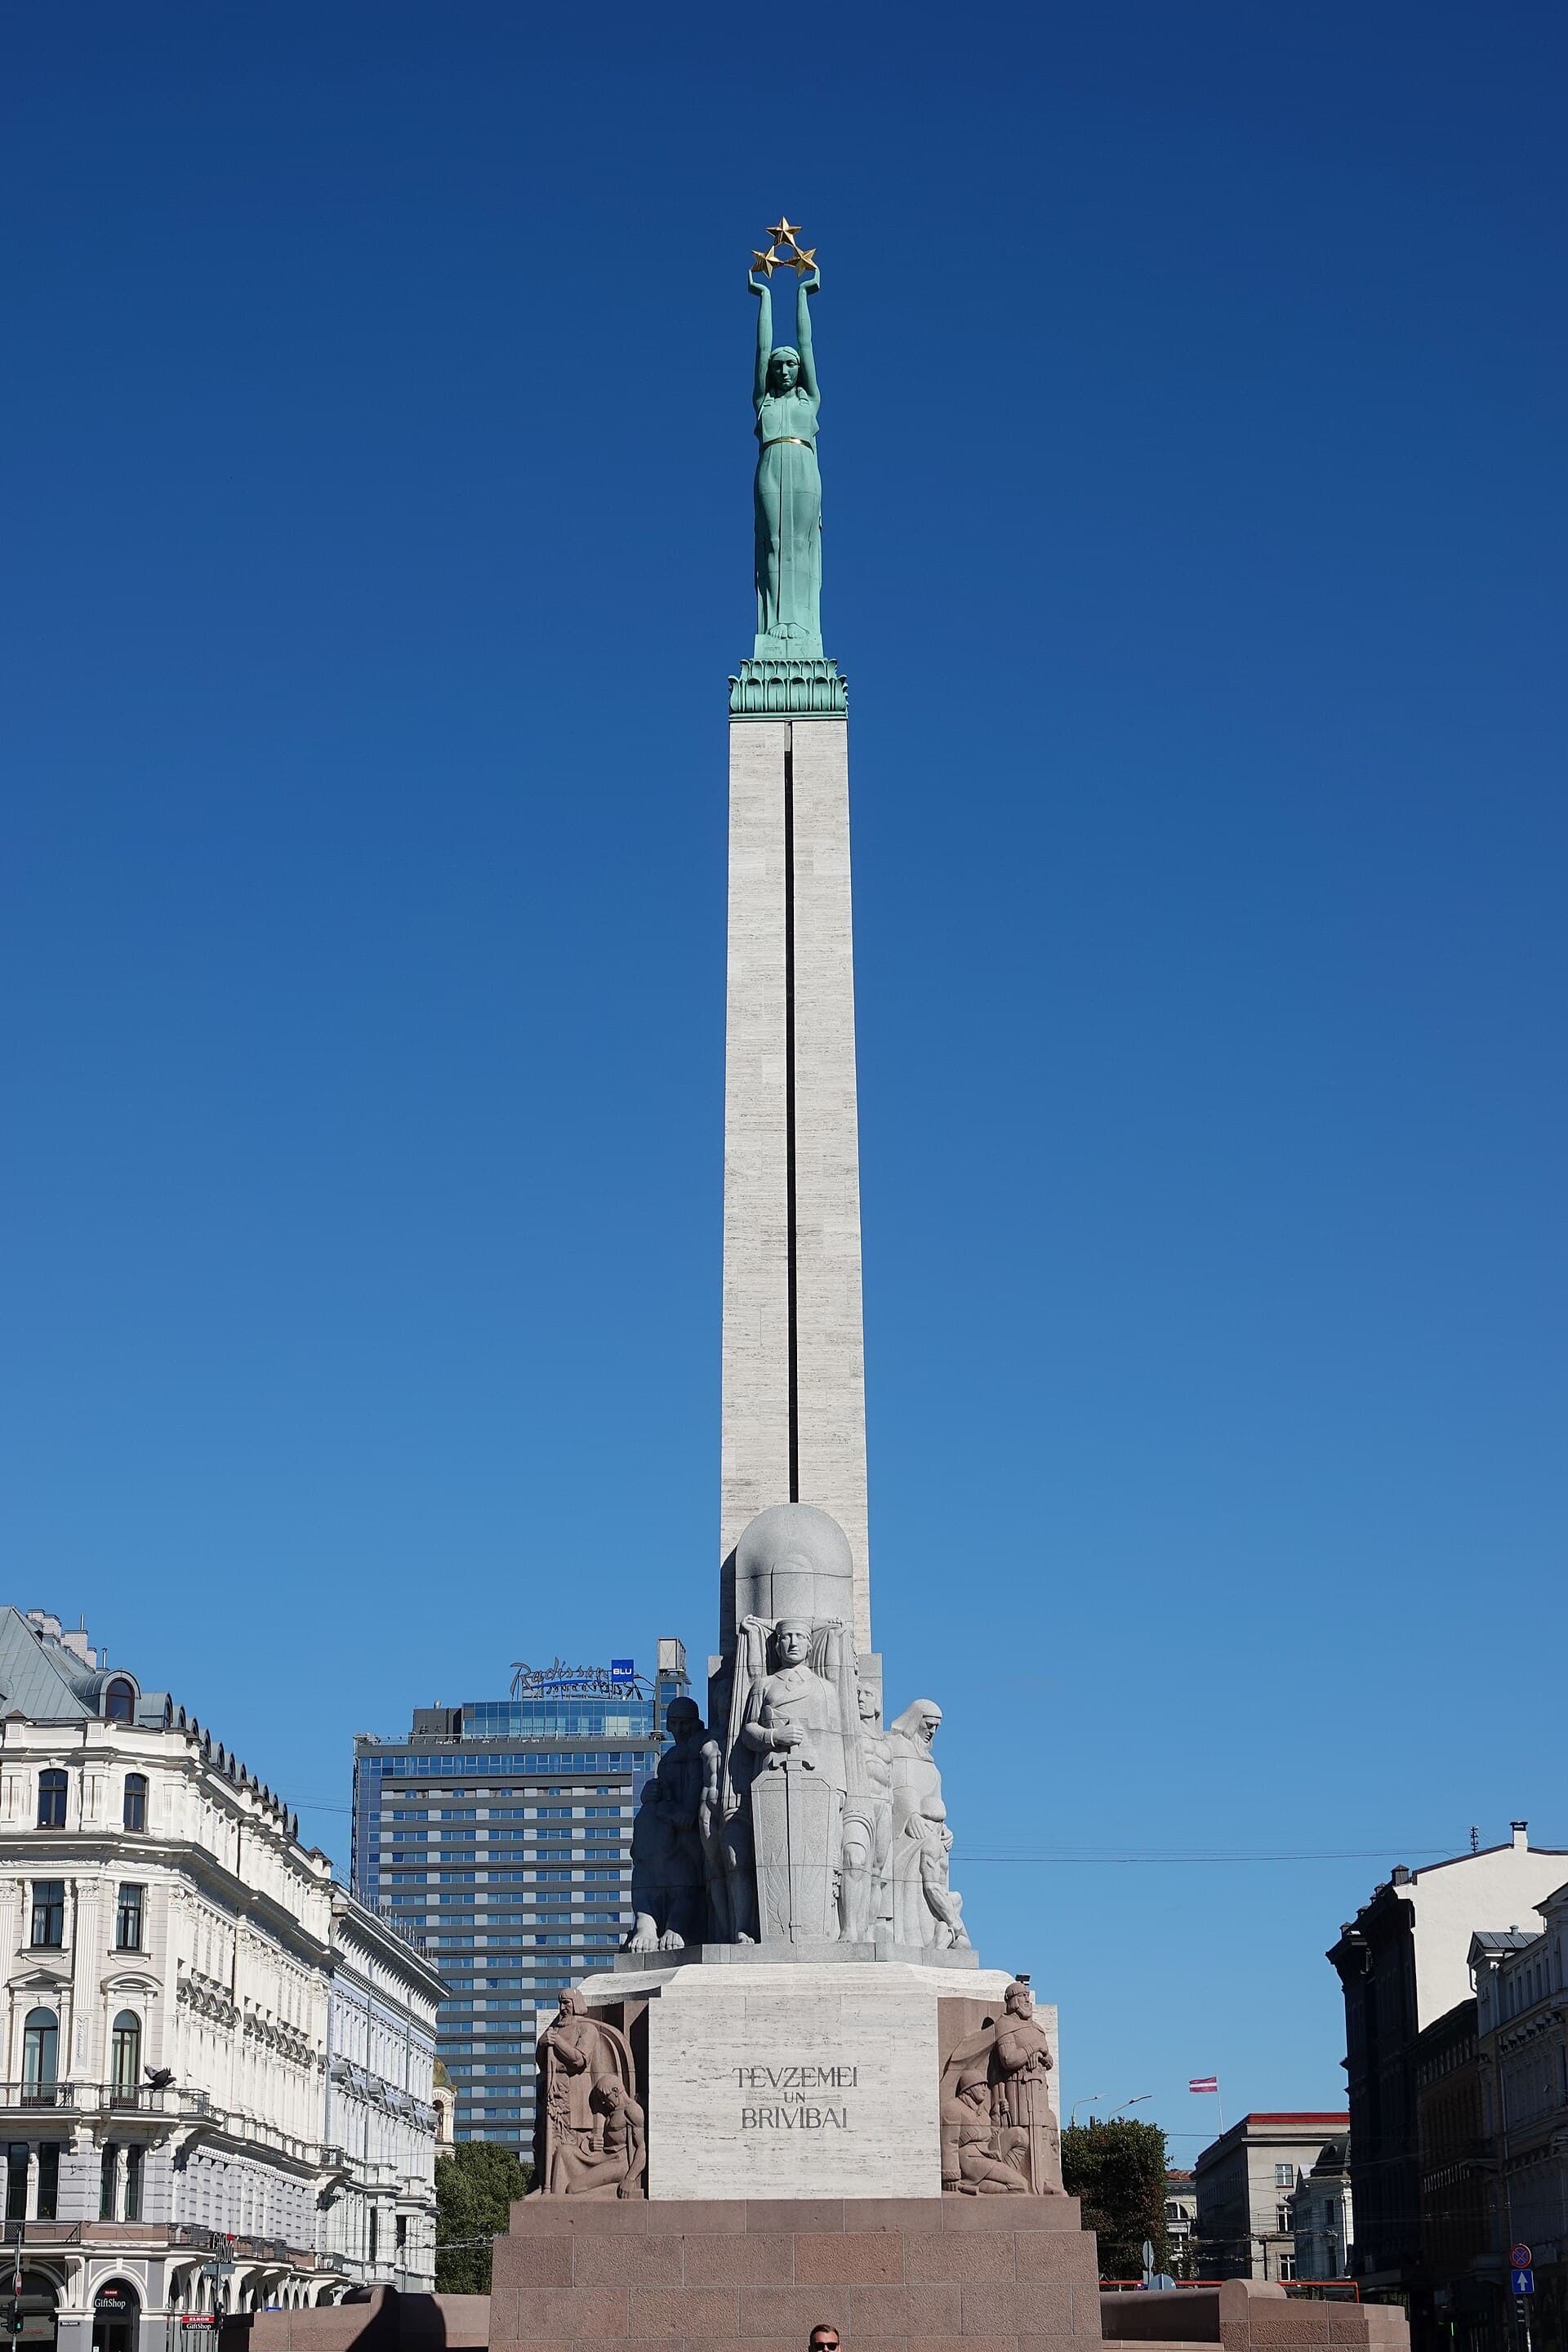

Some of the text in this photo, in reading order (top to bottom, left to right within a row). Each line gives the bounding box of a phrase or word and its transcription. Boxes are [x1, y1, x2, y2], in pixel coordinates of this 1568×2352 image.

[510, 1656, 608, 1695] Radisson
[732, 2065, 858, 2088] TĒVZEMEI
[783, 2091, 805, 2104] UN
[94, 2298, 126, 2310] GiftShop
[186, 2323, 212, 2331] GiftShop
